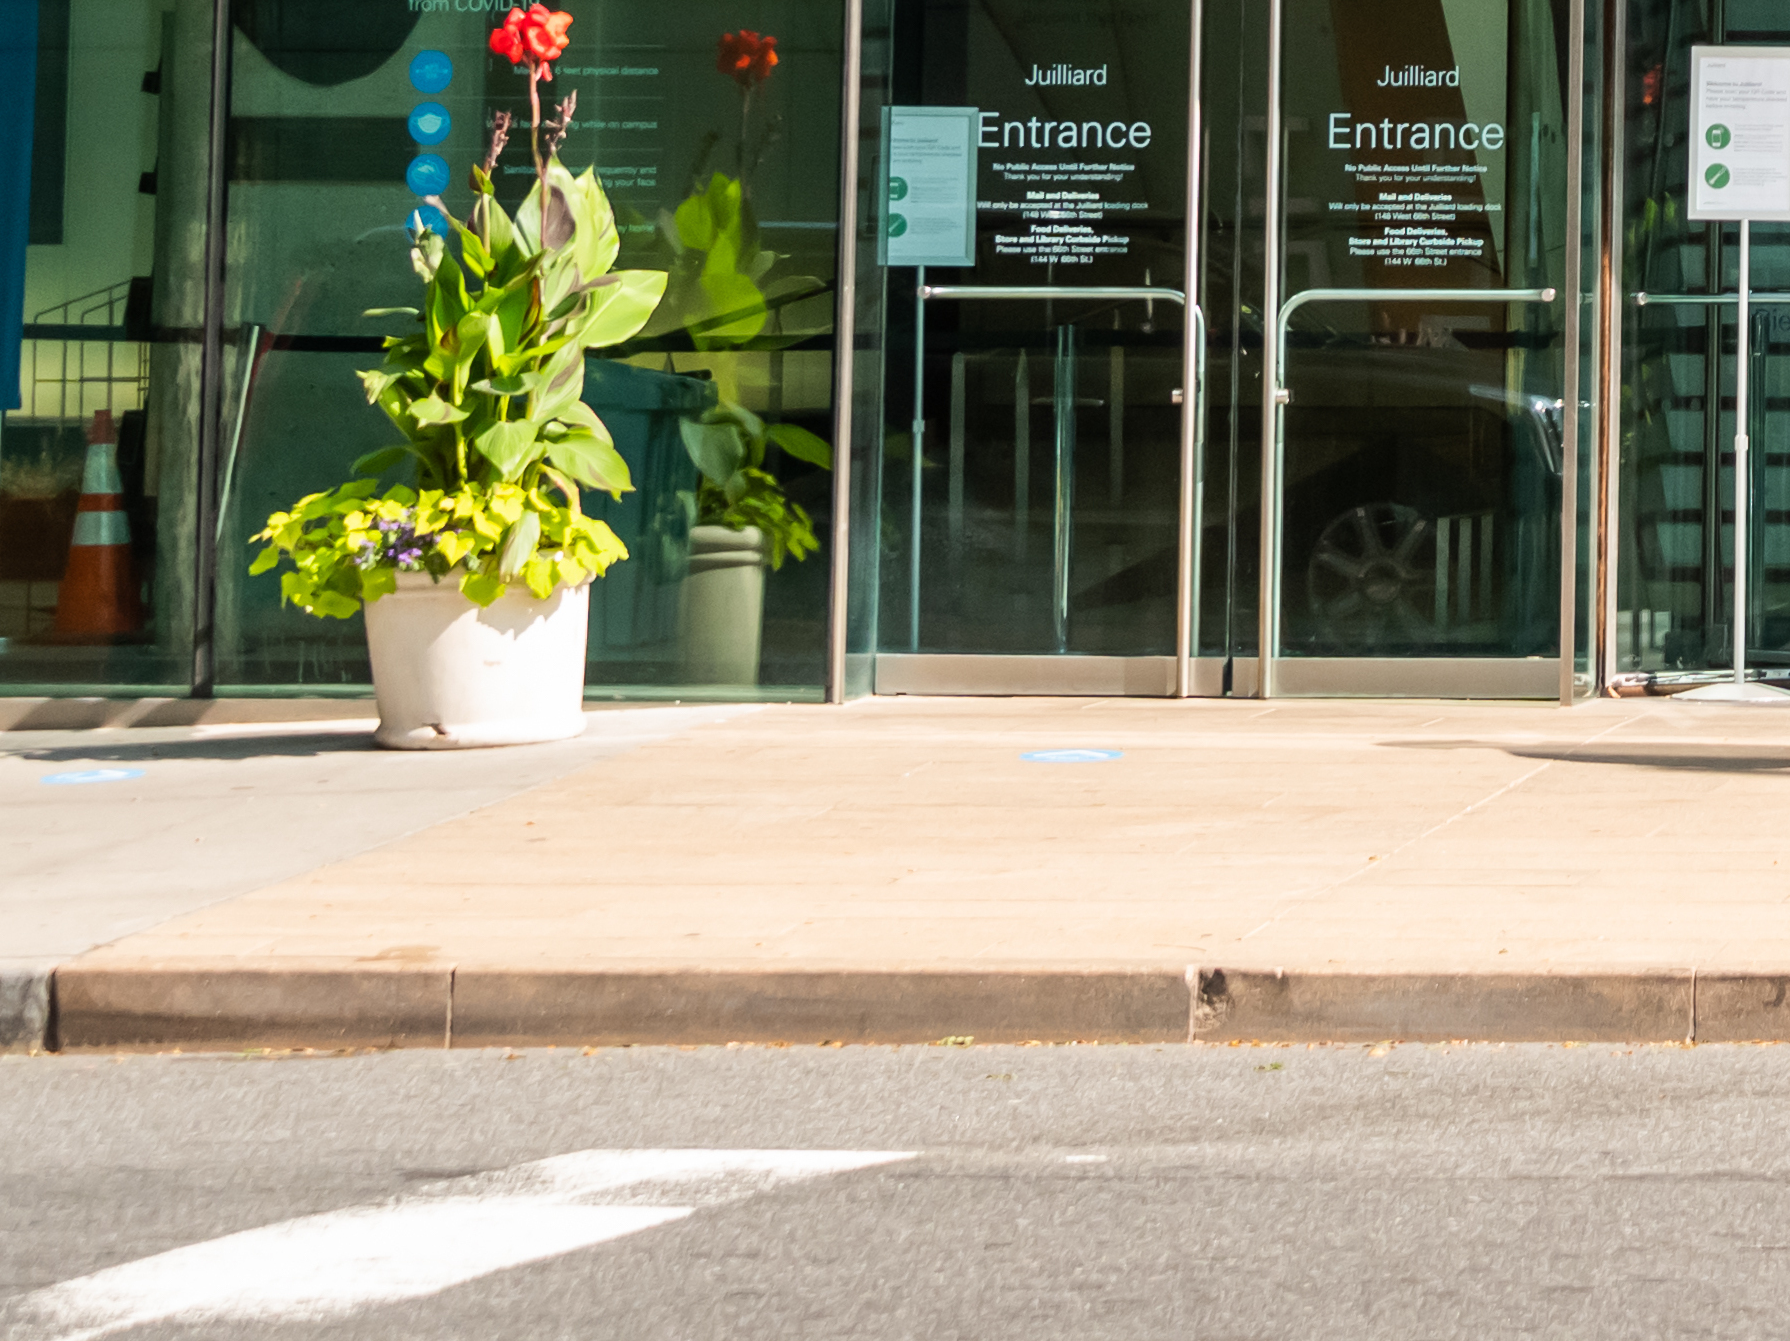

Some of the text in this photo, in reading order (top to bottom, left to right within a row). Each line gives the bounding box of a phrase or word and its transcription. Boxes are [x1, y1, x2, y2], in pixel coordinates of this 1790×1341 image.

[1024, 64, 1107, 86] Juilliard
[1376, 65, 1460, 87] Juilliard
[977, 111, 1152, 149] Entrance
[1328, 112, 1505, 150] Entrance
[1344, 164, 1487, 172] No Public Access Until Further Notice
[1379, 193, 1452, 201] Mail and Deliveries
[1384, 227, 1405, 235] Food
[1349, 237, 1484, 246] Store and Library Curbside Pickup
